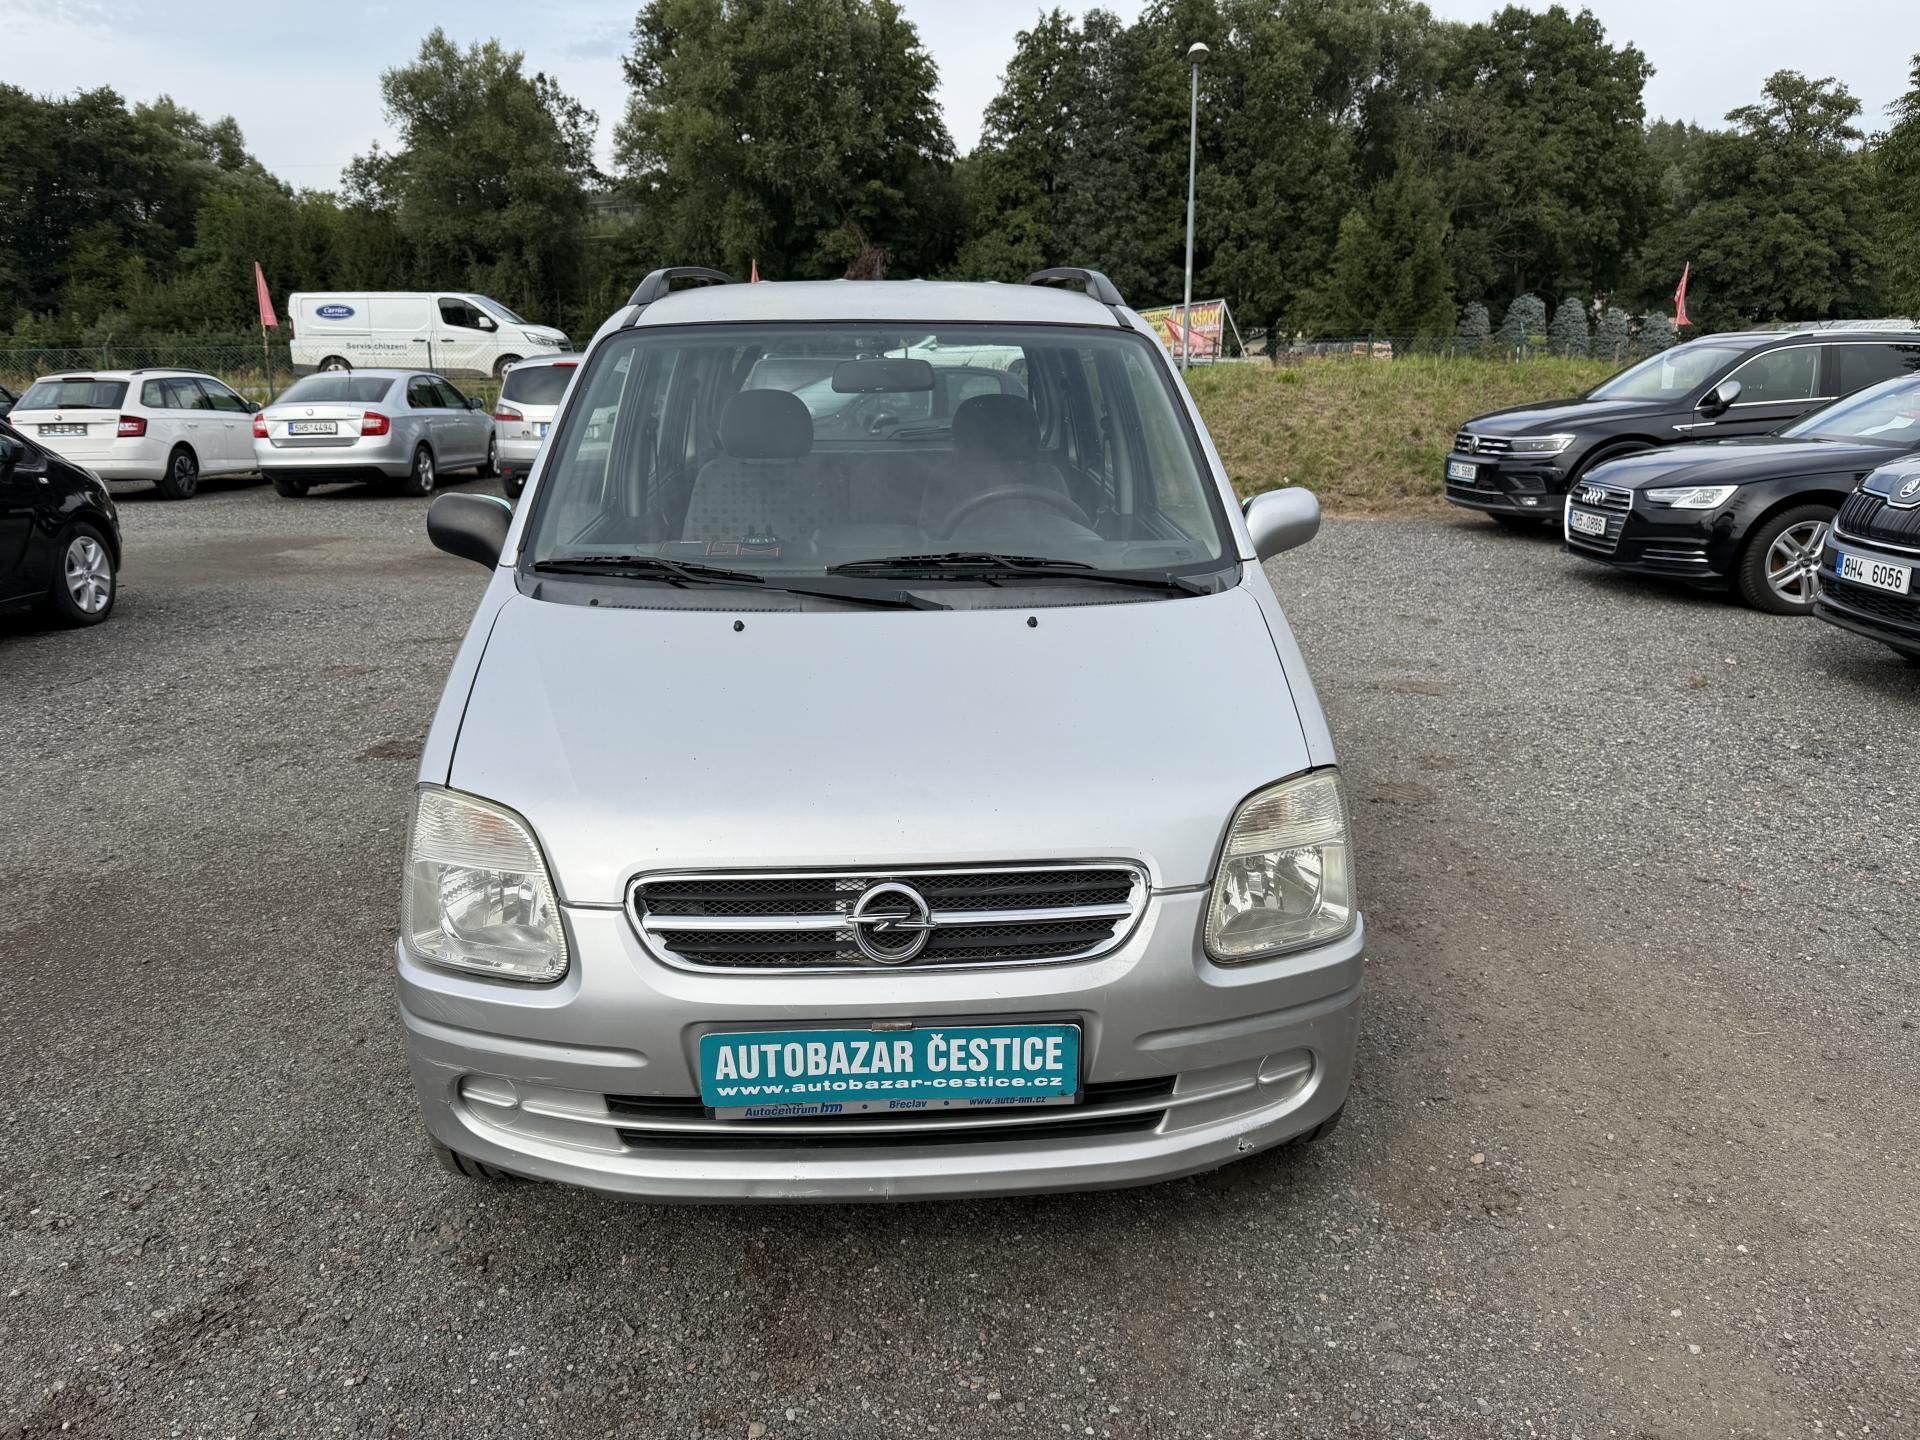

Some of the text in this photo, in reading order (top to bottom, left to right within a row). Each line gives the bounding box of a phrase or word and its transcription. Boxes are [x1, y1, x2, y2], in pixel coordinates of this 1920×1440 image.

[346, 342, 371, 350] Servis
[1843, 557, 1903, 589] 8H4 6056
[715, 1033, 1064, 1081] AUTOBAZAR ČESTICE
[716, 1076, 1063, 1097] www.autobazar-cestice.cz
[744, 1104, 818, 1118] Autocentrum
